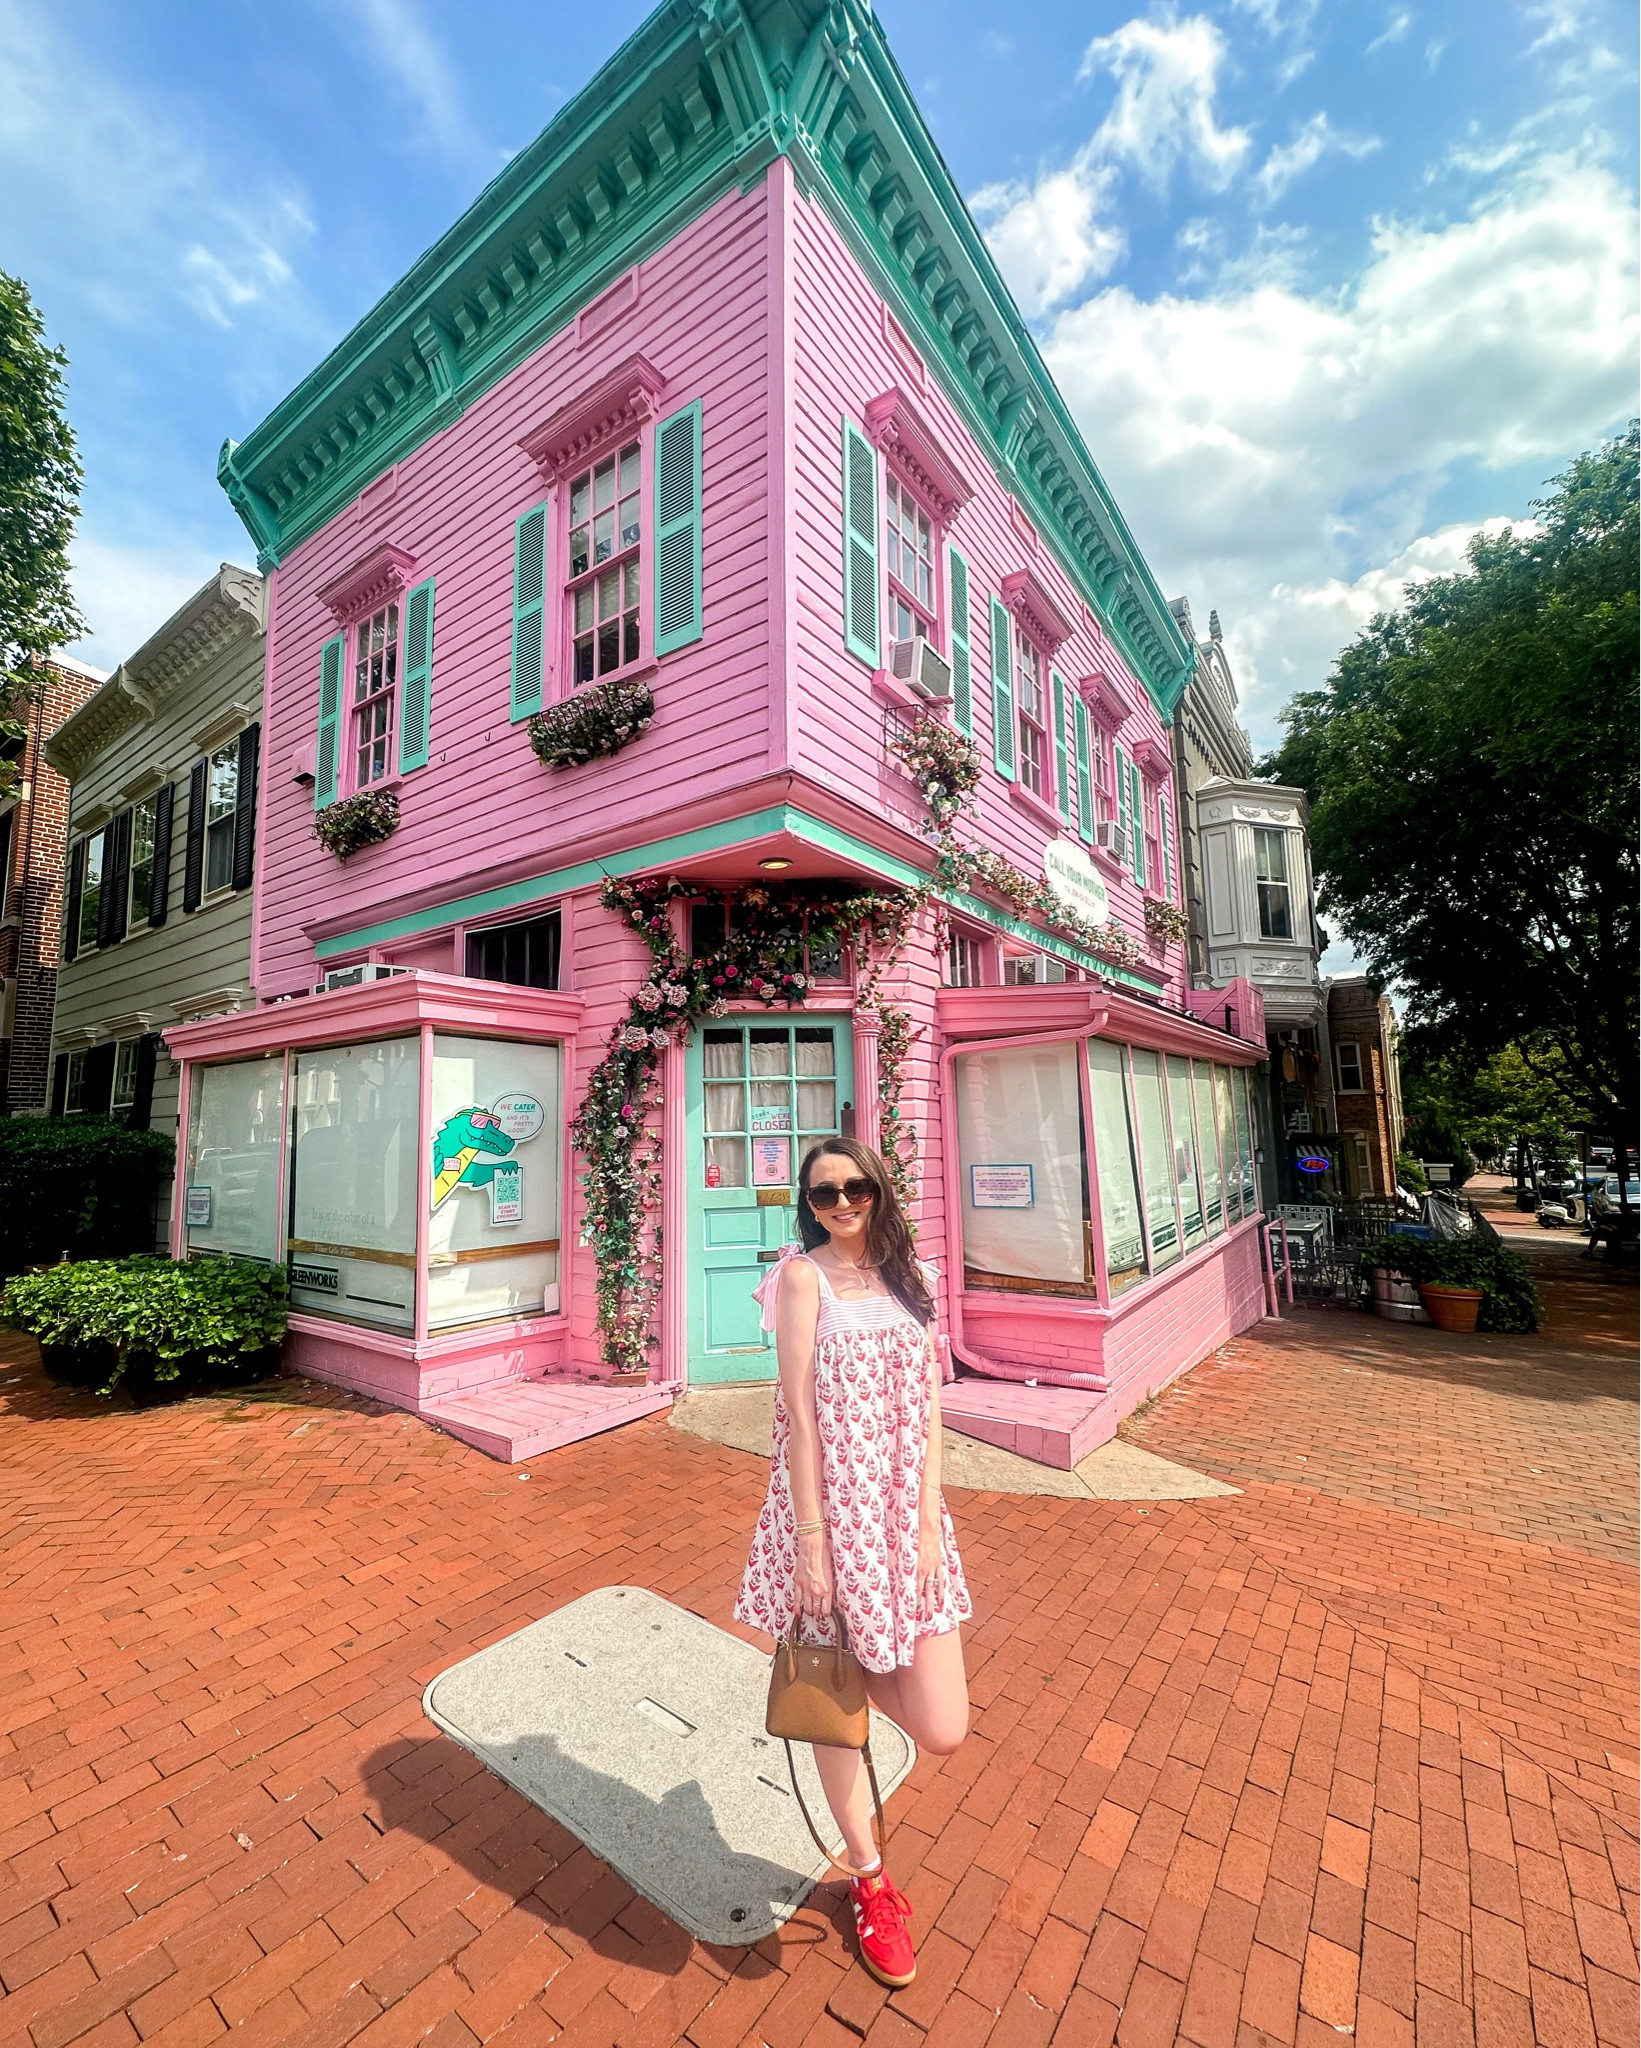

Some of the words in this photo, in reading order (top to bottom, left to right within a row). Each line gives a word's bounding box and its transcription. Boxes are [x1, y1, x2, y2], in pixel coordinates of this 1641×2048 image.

[1049, 853, 1066, 876] CALL
[1067, 865, 1082, 888] YOUR
[1083, 875, 1105, 902] MOTHER
[752, 1120, 792, 1131] CLOSED
